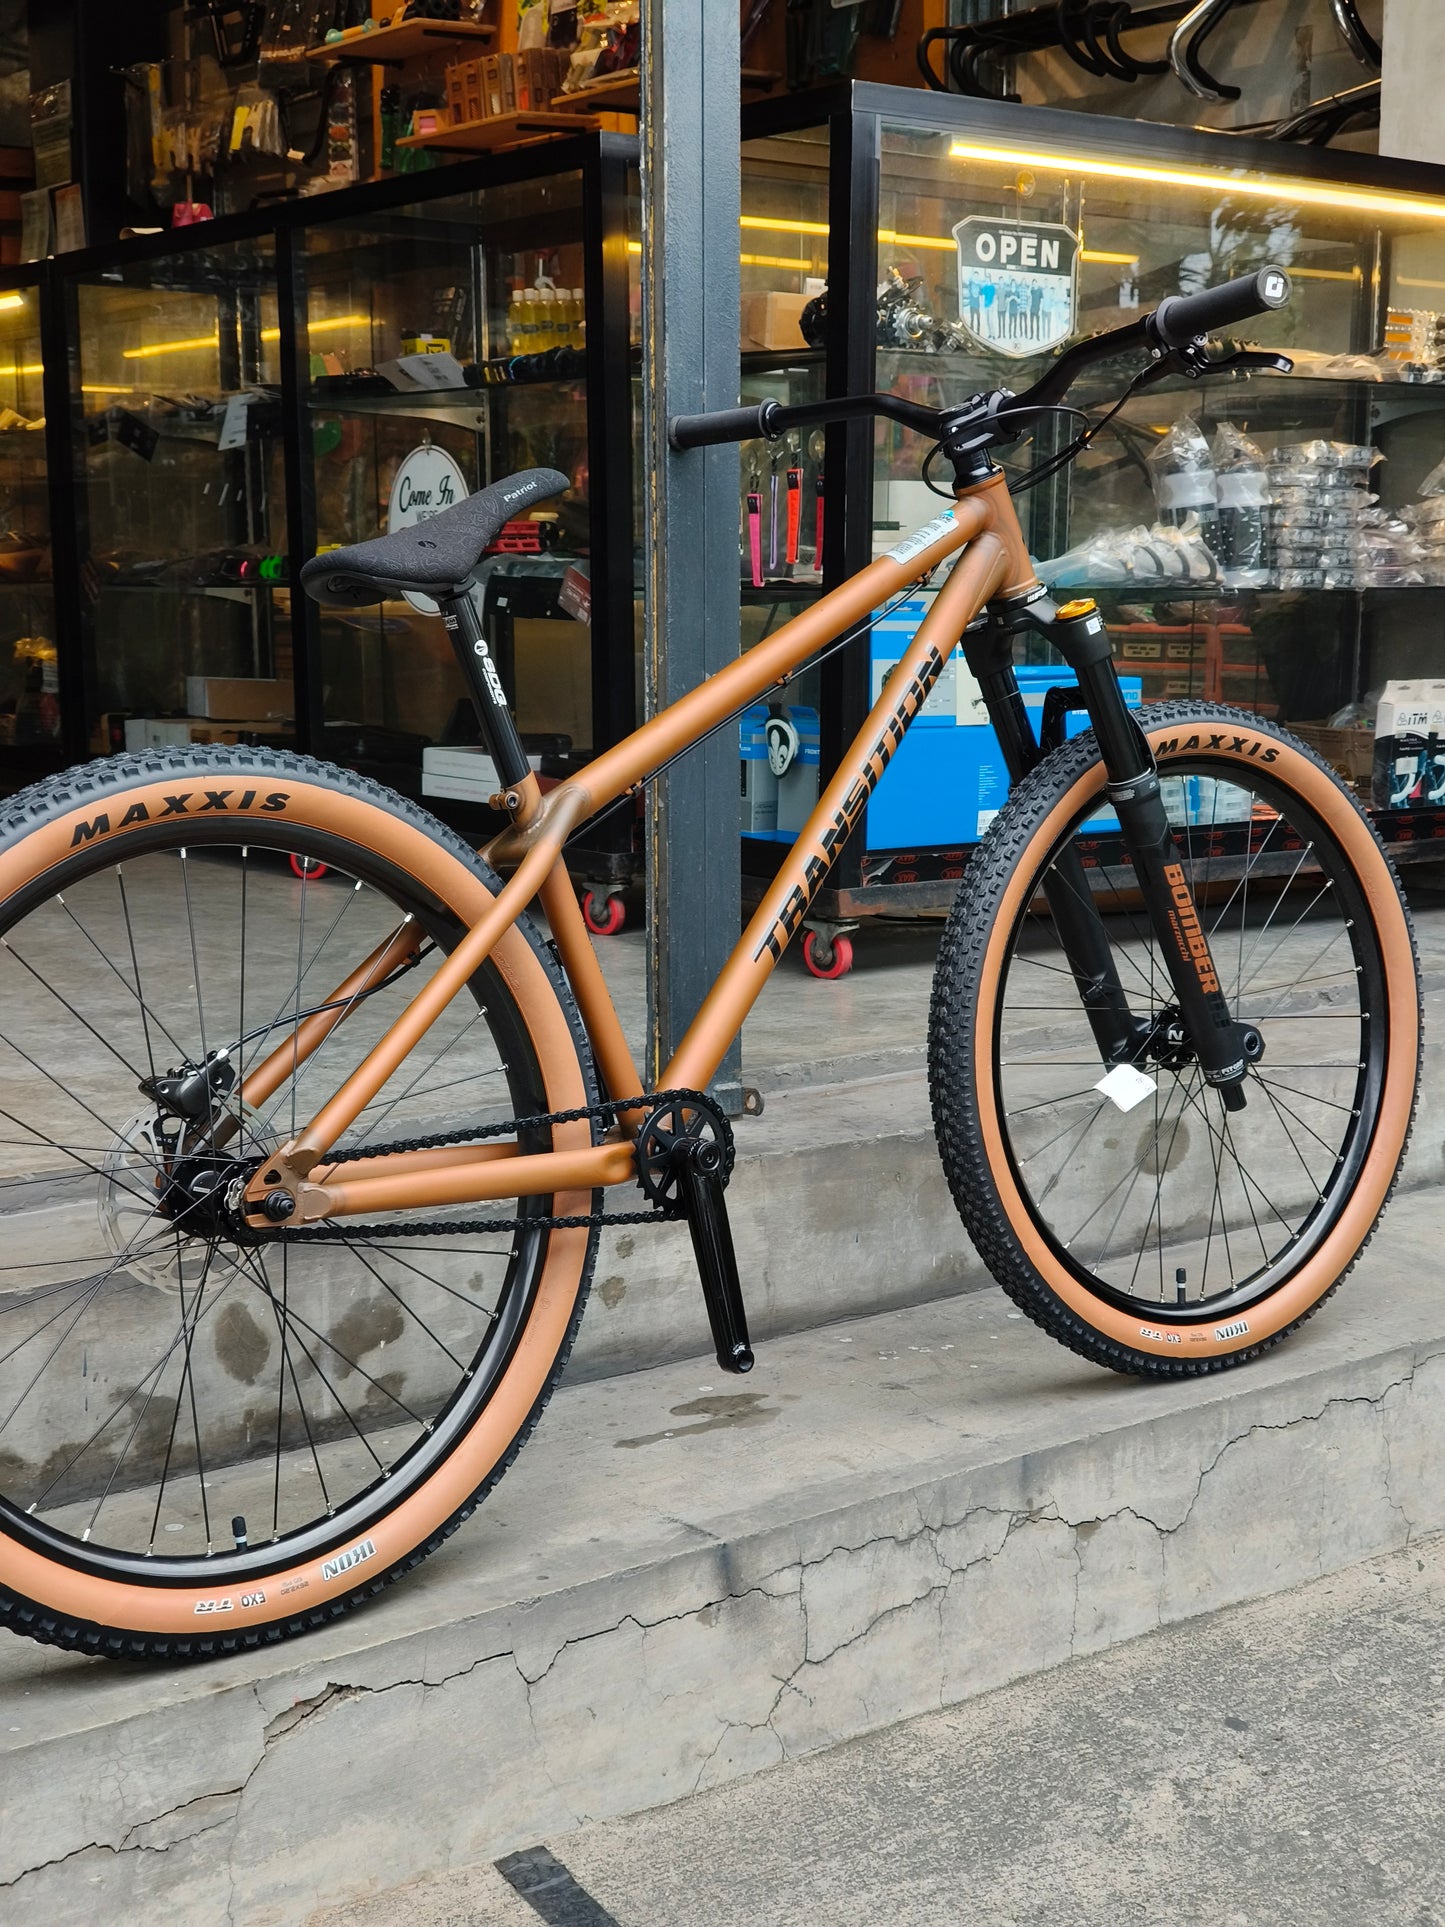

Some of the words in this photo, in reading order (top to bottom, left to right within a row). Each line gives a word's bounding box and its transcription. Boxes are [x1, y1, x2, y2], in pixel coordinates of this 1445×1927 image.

[975, 232, 1060, 269] OPEN
[399, 475, 432, 513] Come
[436, 474, 455, 506] In
[503, 481, 538, 503] Patriot
[483, 656, 507, 707] SDG
[1154, 734, 1280, 763] MAXXIS
[70, 789, 292, 849] MAXXIS
[752, 640, 945, 963] TRANSITION
[1163, 863, 1219, 994] BOMBER
[1168, 909, 1192, 962] marzocchi
[1216, 1321, 1249, 1341] IKON
[322, 1540, 376, 1580] IKON
[195, 1599, 234, 1614] TR
[240, 1591, 267, 1608] EXO
